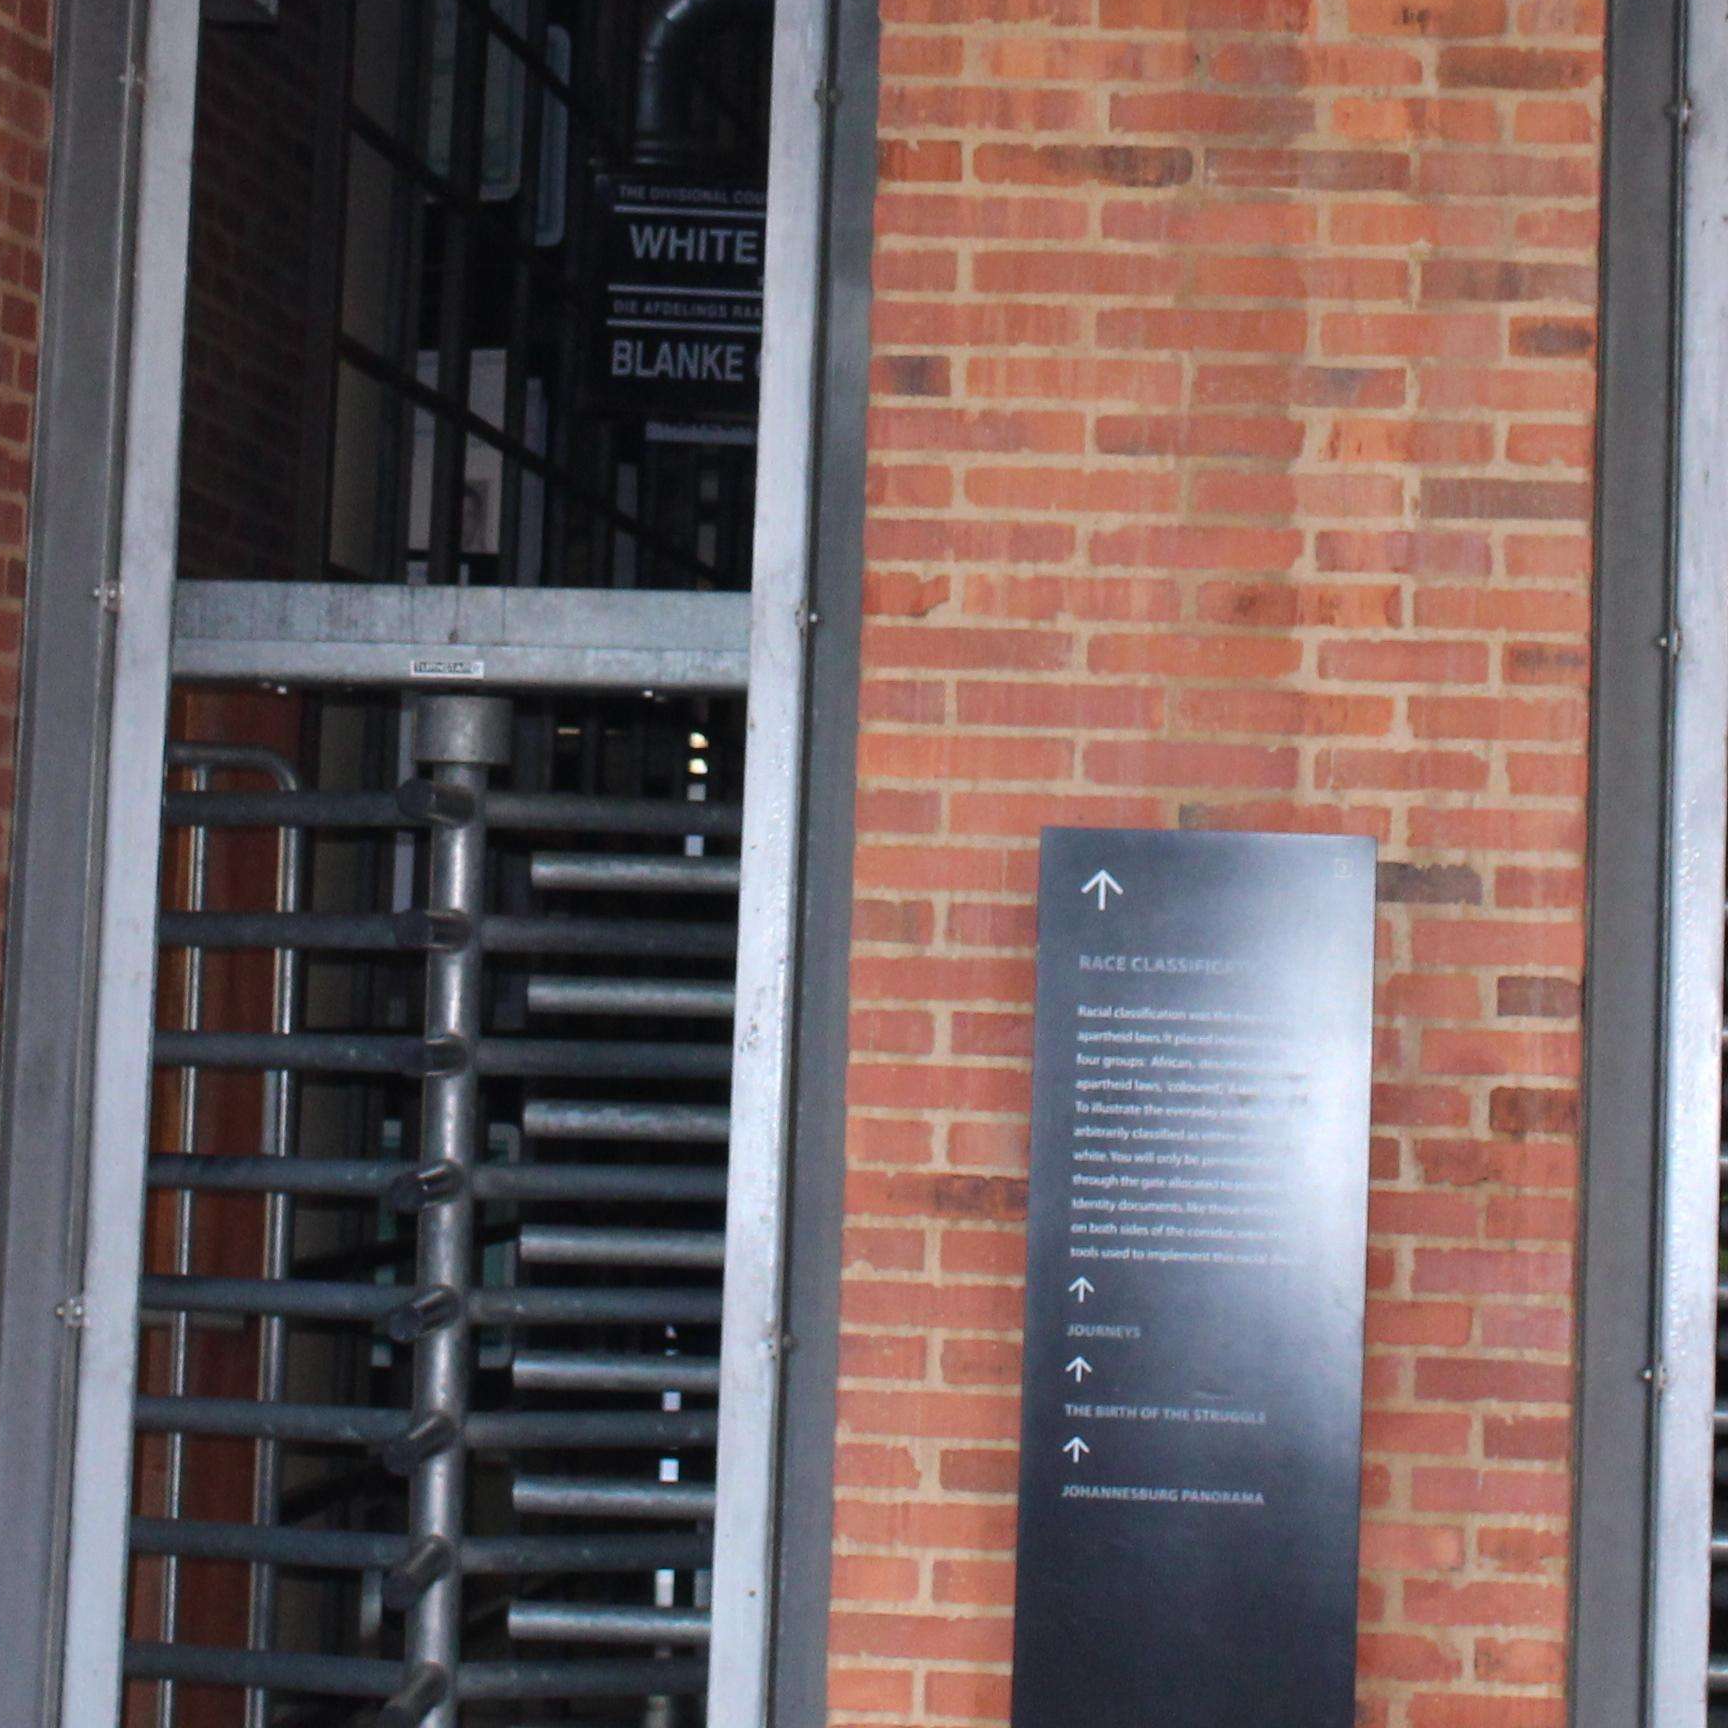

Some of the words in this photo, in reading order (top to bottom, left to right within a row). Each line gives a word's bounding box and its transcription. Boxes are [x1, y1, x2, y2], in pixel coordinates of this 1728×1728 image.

[619, 185, 646, 201] THE
[629, 224, 759, 265] WHITE
[614, 299, 637, 314] DIE
[611, 339, 745, 382] BLANKE
[1079, 954, 1126, 972] RACE
[1077, 1005, 1112, 1018] Racial
[1114, 1007, 1186, 1021] classification
[1077, 1031, 1134, 1044] apartheid
[1077, 1053, 1100, 1065] four
[1076, 1079, 1132, 1092] apartheid
[1076, 1101, 1089, 1114] To
[1144, 1104, 1163, 1116] the
[1072, 1199, 1115, 1213] Identity
[1089, 1223, 1118, 1235] both
[1070, 1247, 1100, 1260] tools
[1101, 1248, 1130, 1260] used
[1132, 1249, 1145, 1260] to
[1067, 1324, 1141, 1339] JOURNEYS
[1065, 1403, 1092, 1418] THE
[1096, 1405, 1137, 1419] BIRTH
[1140, 1405, 1159, 1420] OF
[1164, 1407, 1191, 1421] THE
[1194, 1408, 1266, 1424] STRUGGLE
[1061, 1485, 1178, 1502] JOHANNESBURG
[1182, 1489, 1264, 1505] PANORAMA
